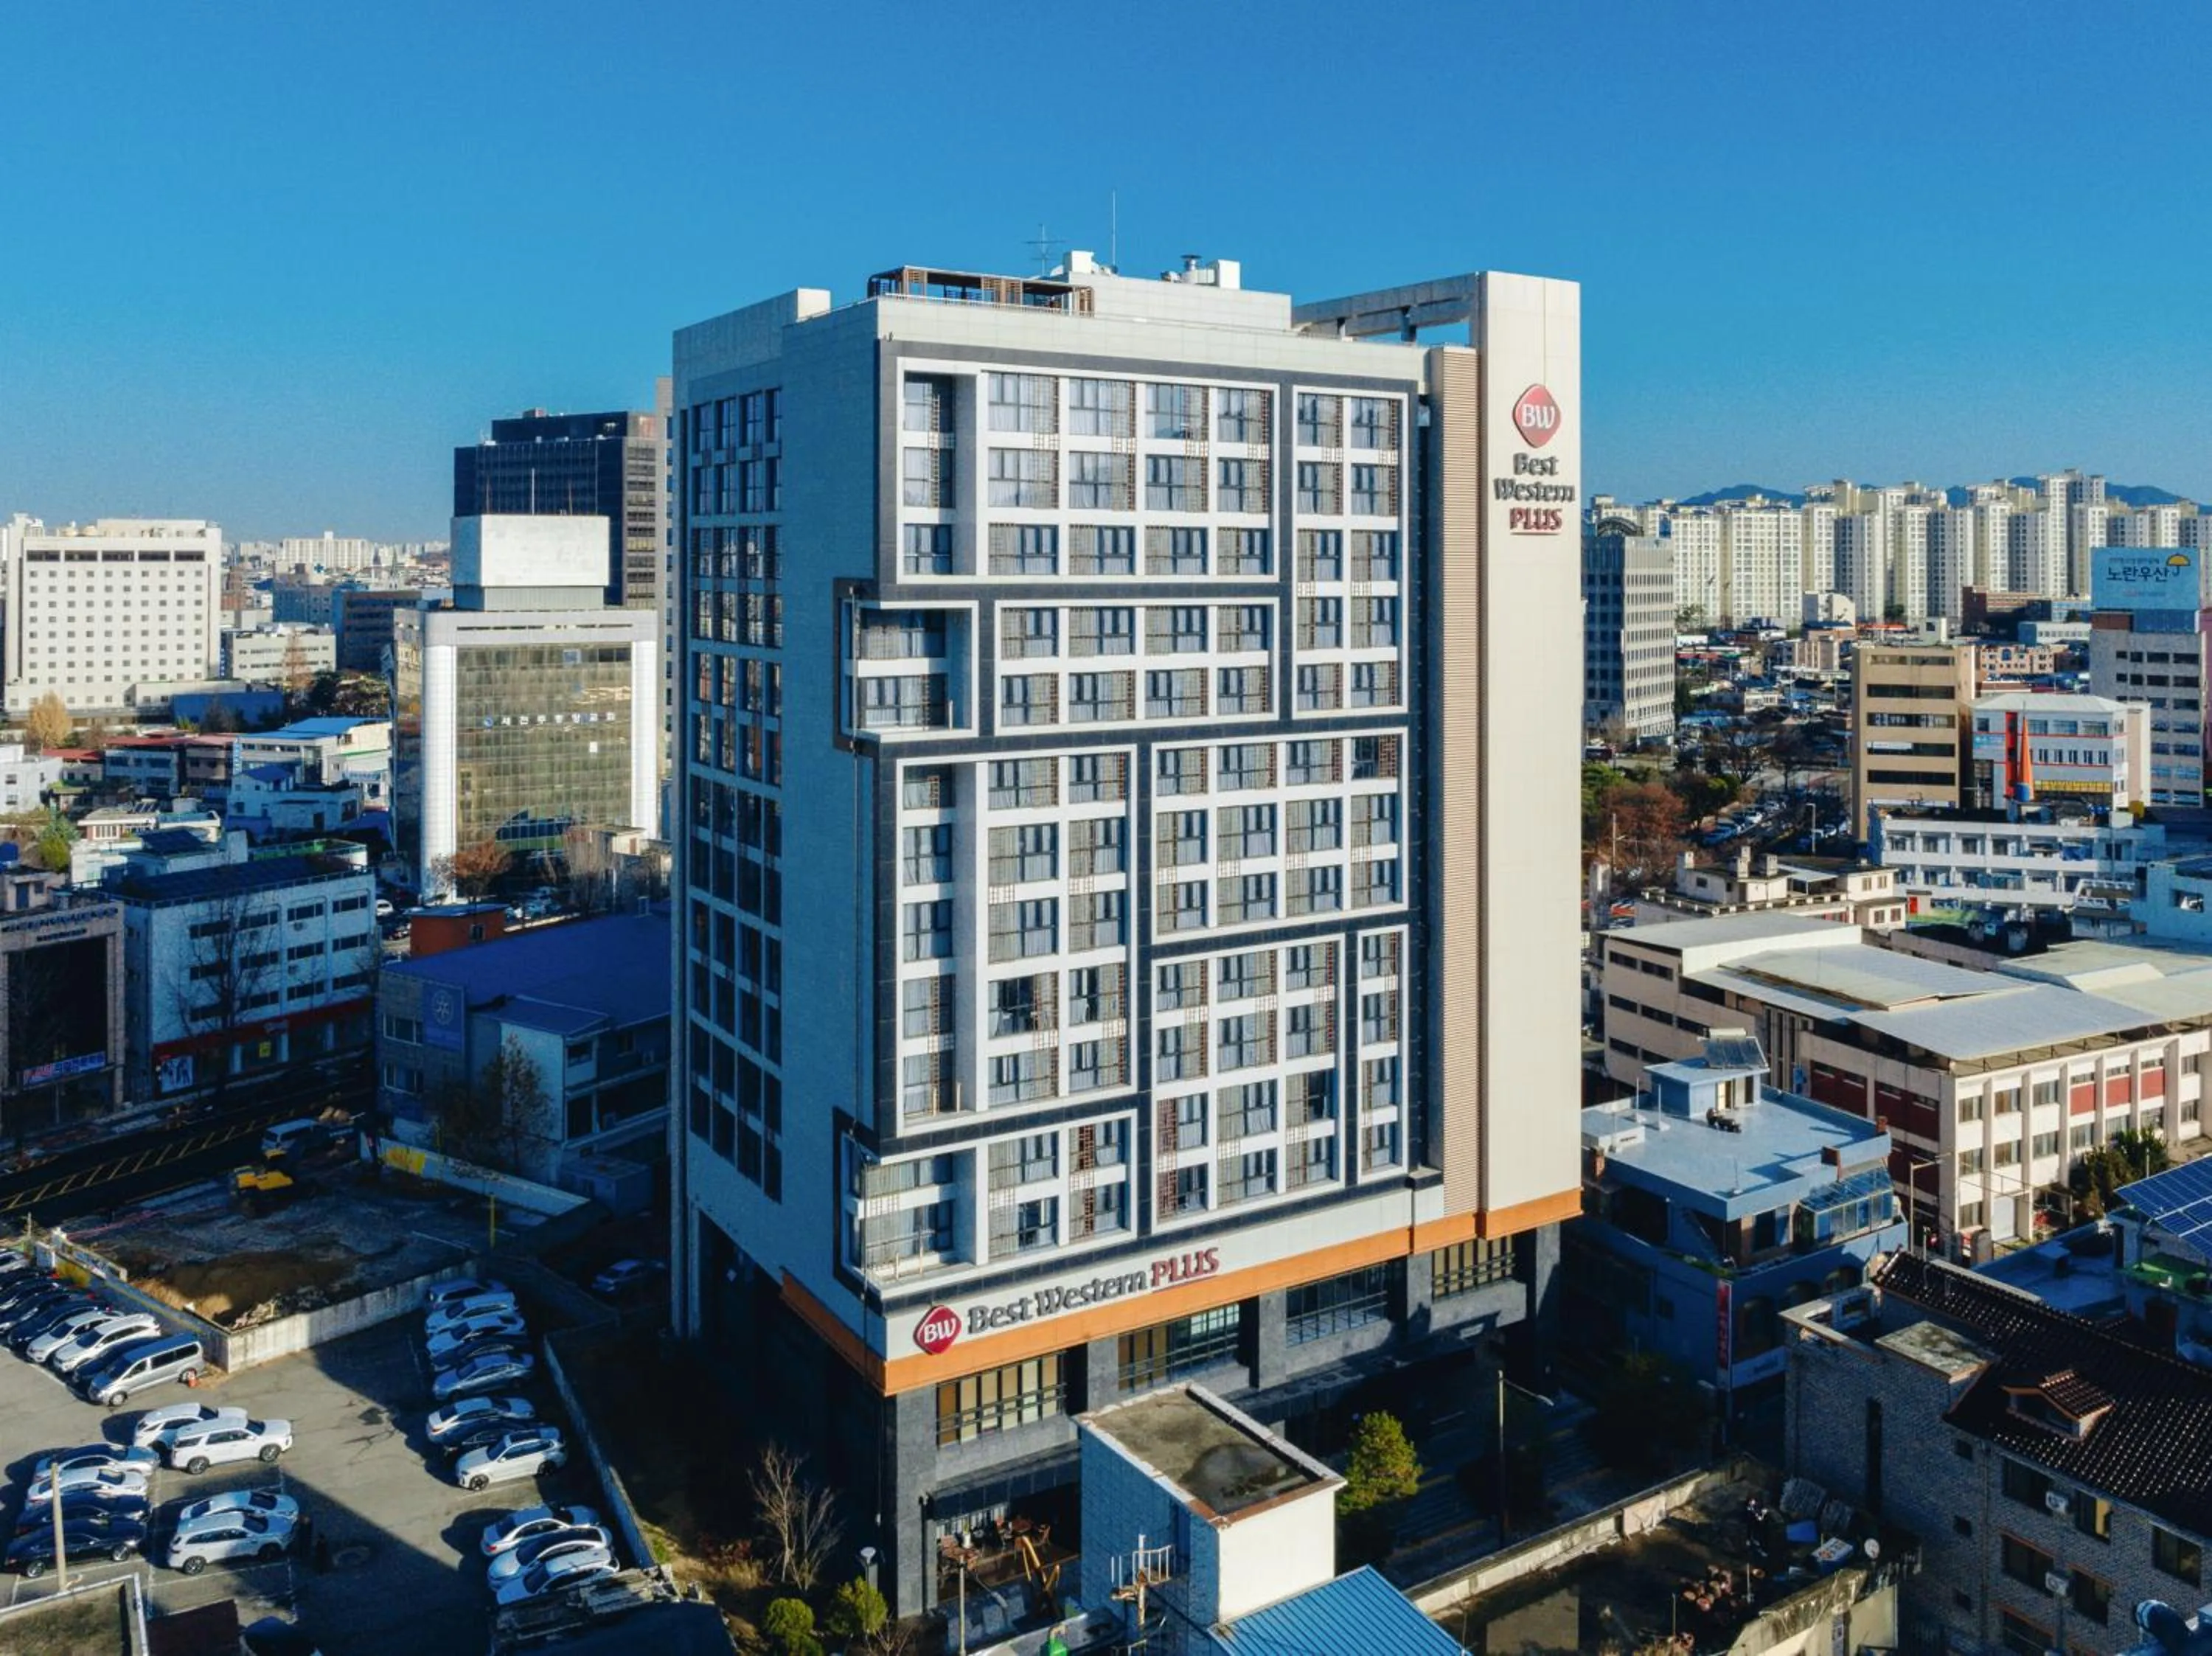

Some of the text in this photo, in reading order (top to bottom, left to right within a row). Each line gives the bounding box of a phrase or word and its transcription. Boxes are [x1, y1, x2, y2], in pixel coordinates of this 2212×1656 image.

[1521, 403, 1556, 430] BW
[1513, 452, 1559, 476] Best
[1493, 478, 1576, 503] Western
[1509, 507, 1563, 531] PLUS
[2106, 566, 2170, 582] 노란우산
[923, 1246, 1221, 1345] BW Best Western PLUS
